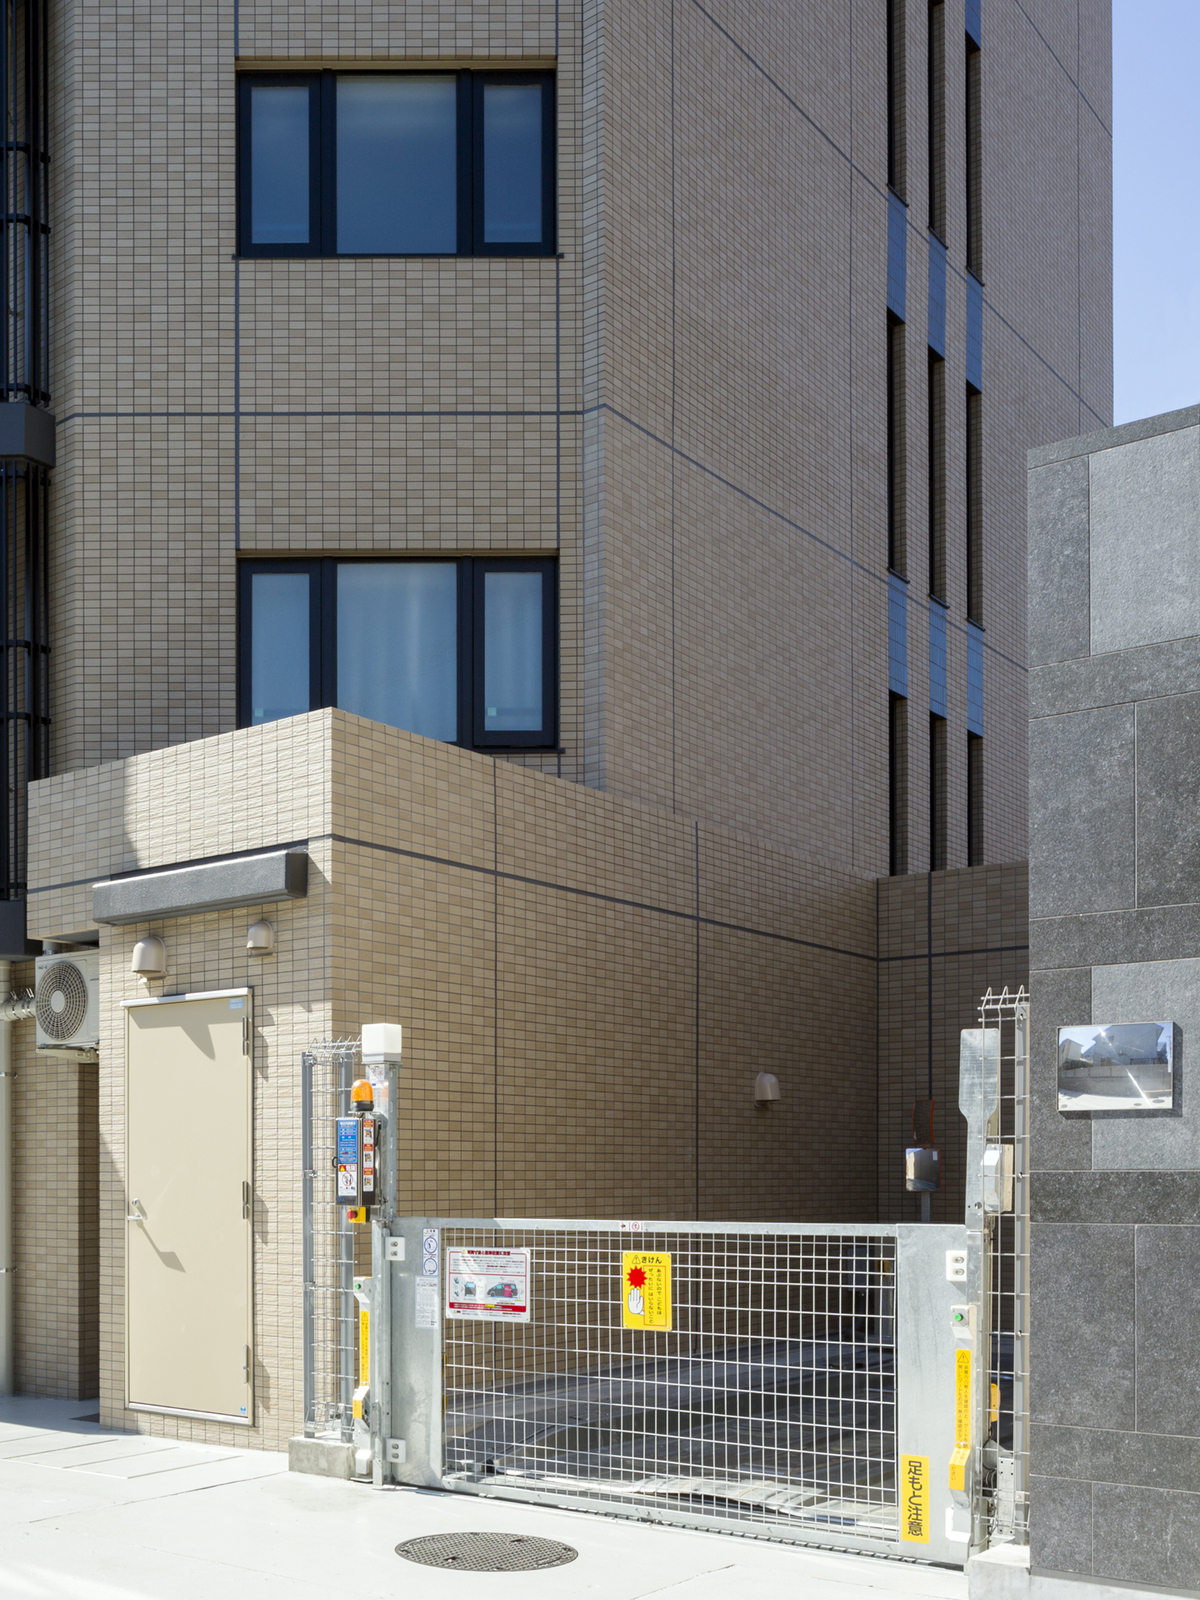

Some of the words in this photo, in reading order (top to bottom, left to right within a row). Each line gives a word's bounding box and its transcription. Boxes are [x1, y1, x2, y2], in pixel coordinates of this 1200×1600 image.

[641, 1256, 662, 1264] きけん
[907, 1460, 923, 1537] 足もと注意
